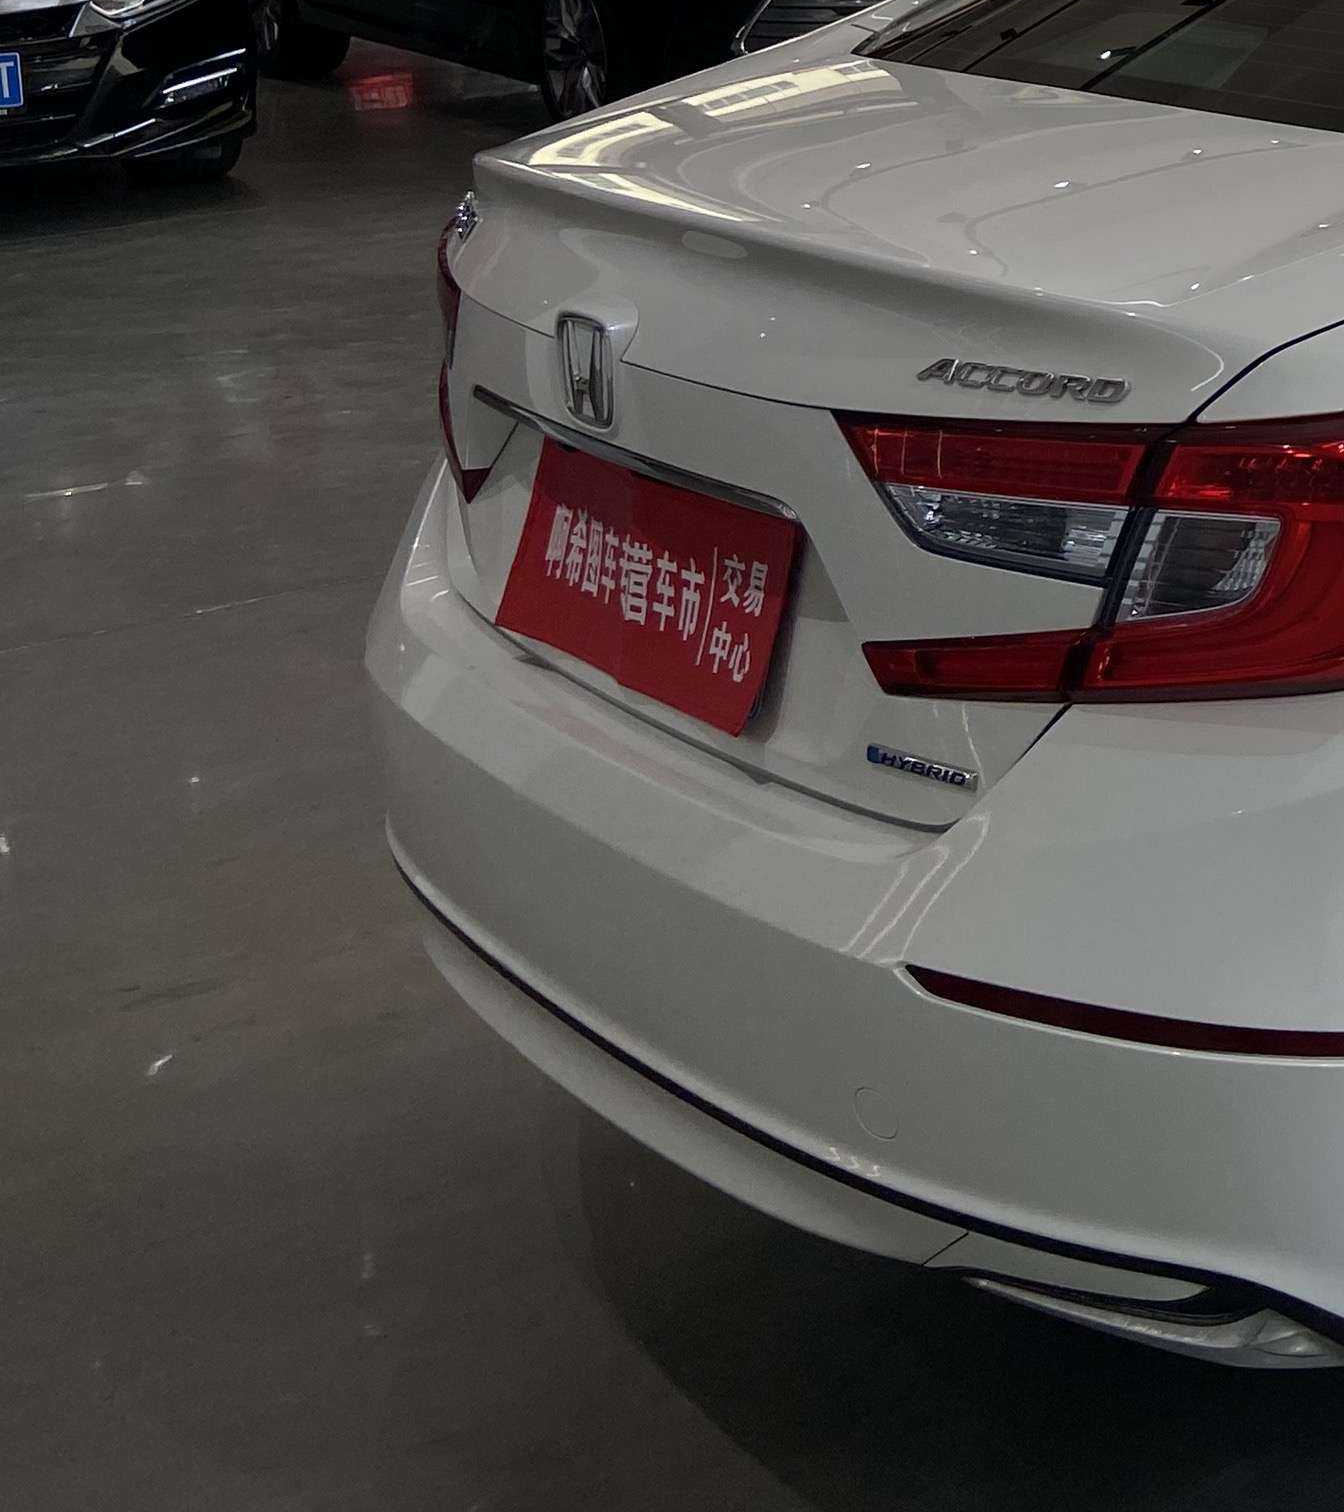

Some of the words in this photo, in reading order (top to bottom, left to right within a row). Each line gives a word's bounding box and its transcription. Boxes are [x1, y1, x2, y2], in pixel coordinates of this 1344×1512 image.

[916, 356, 1133, 404] ACCORD
[720, 553, 769, 617] 交易
[708, 620, 751, 683] 中心
[881, 752, 967, 786] HYBRID
